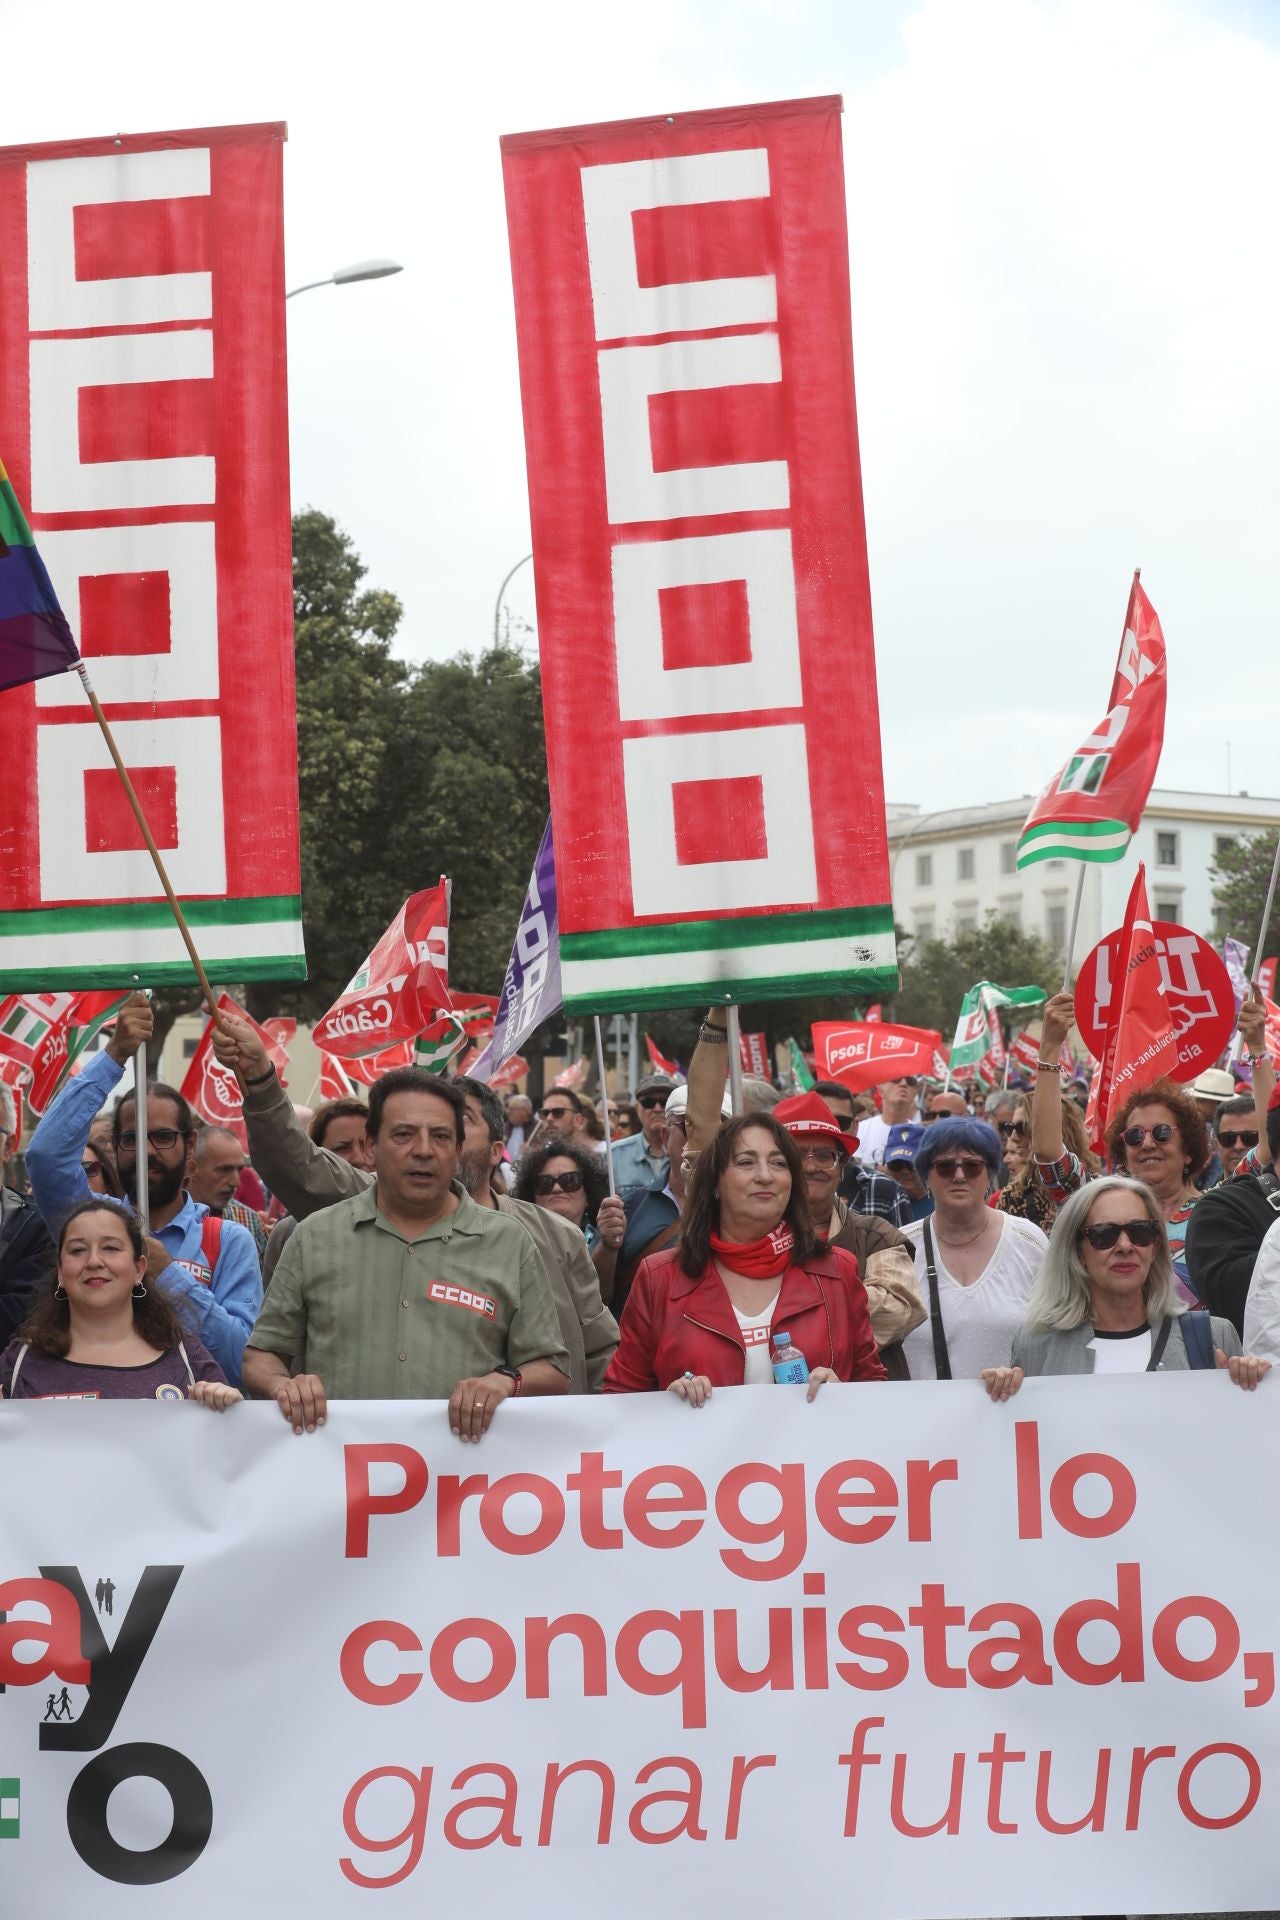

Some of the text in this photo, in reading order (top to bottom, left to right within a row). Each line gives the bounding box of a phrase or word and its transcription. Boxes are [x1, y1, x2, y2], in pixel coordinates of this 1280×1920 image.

[26, 148, 226, 902] CCOO
[580, 148, 818, 916] CCOO
[830, 1042, 866, 1064] PSOE
[431, 1284, 485, 1310] CCOO
[344, 1421, 1137, 1582] Proteger lo
[340, 1562, 1276, 1729] conquistado,
[340, 1717, 1262, 1889] ganar futuro
